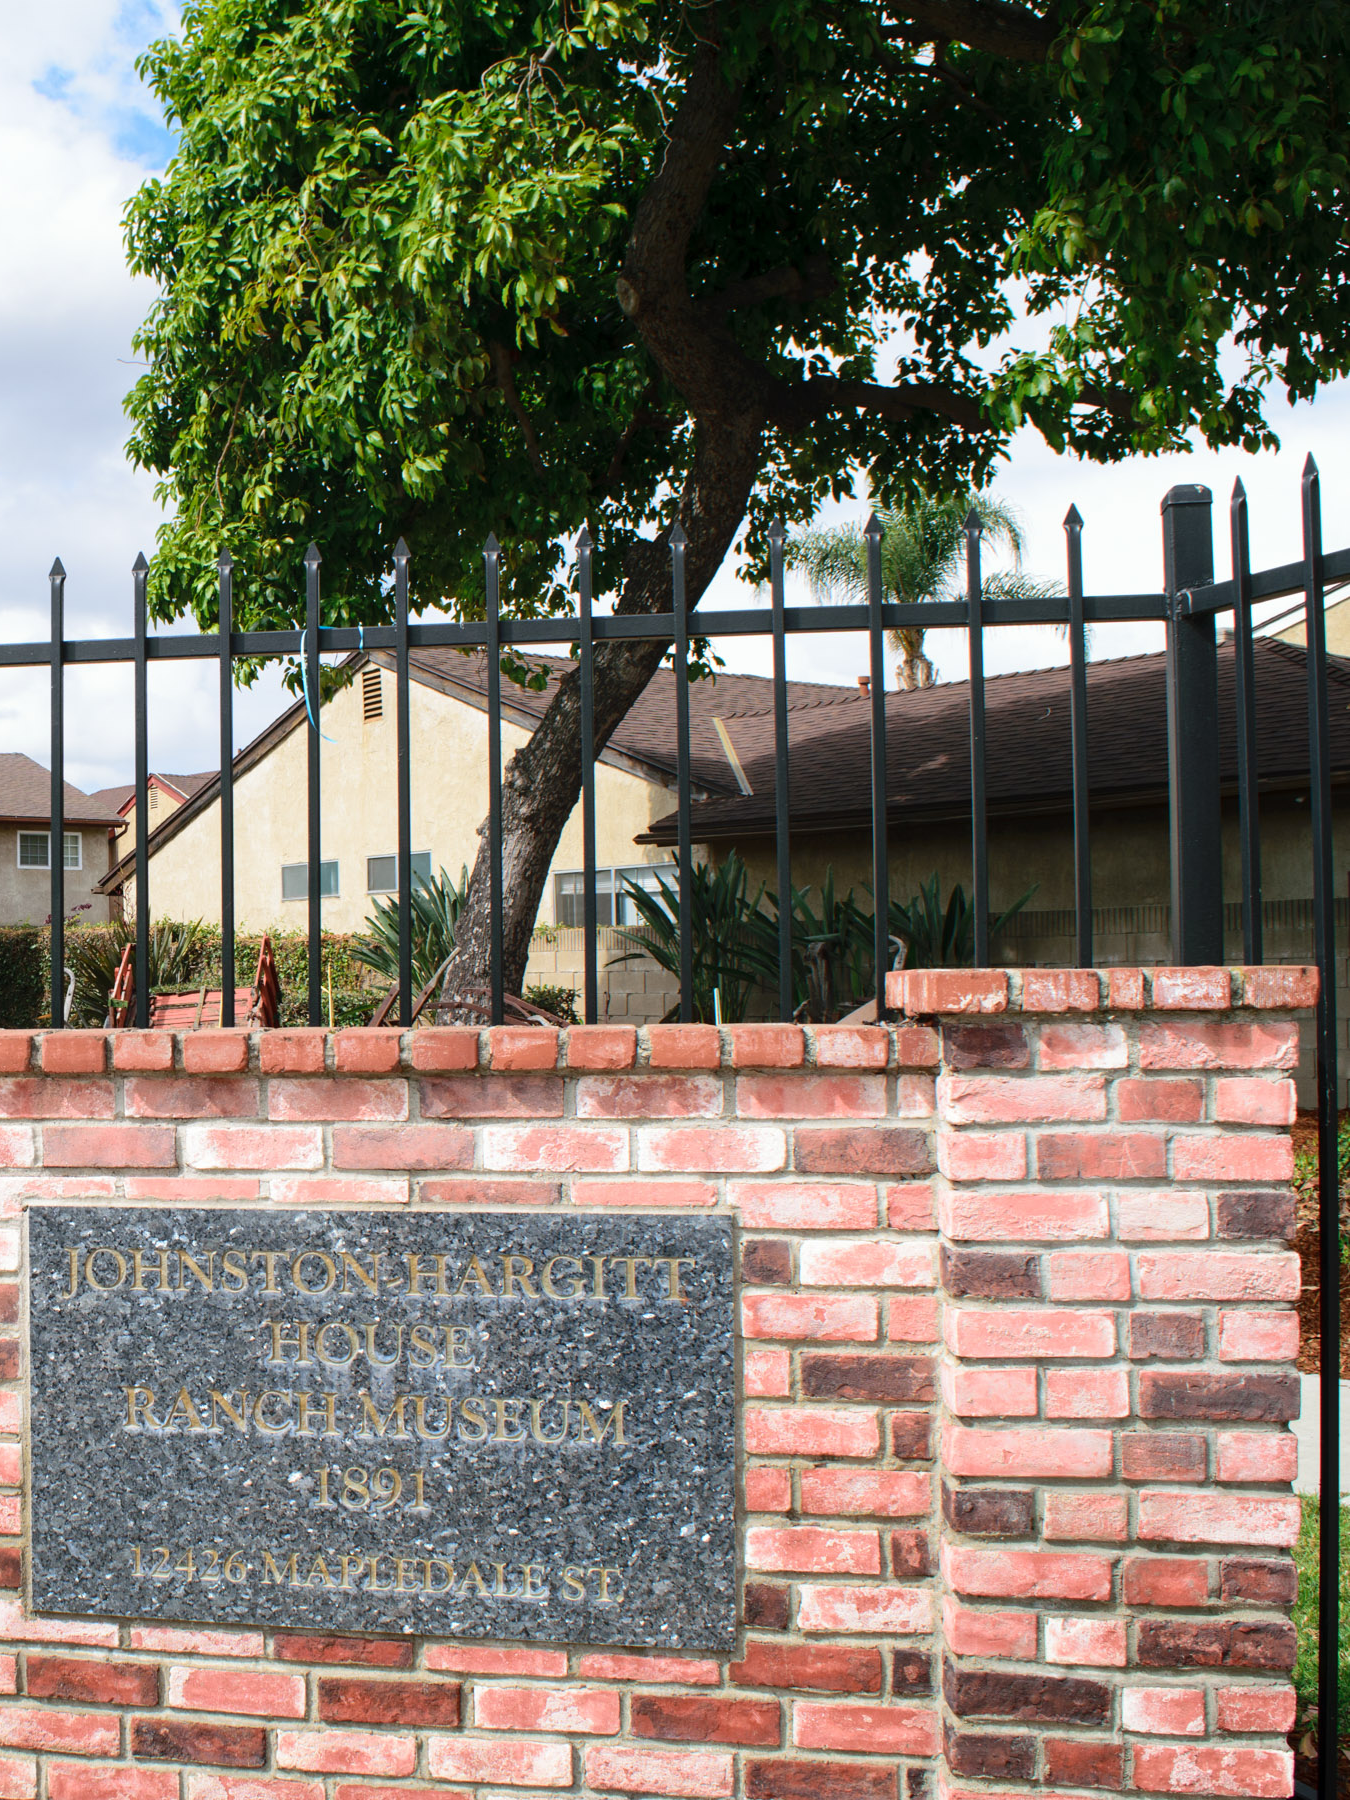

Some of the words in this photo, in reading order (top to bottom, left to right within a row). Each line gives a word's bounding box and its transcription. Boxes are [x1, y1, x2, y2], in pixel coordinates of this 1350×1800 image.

[63, 1247, 697, 1301] JOHNSTON-HARGITT
[266, 1320, 477, 1368] HOUSE
[123, 1385, 340, 1437] RANCH
[359, 1396, 630, 1446] MUSEUM
[314, 1466, 428, 1511] 1891
[130, 1546, 247, 1584] 12426
[261, 1551, 547, 1599] MAPLEDALE
[560, 1565, 625, 1602] ST.
